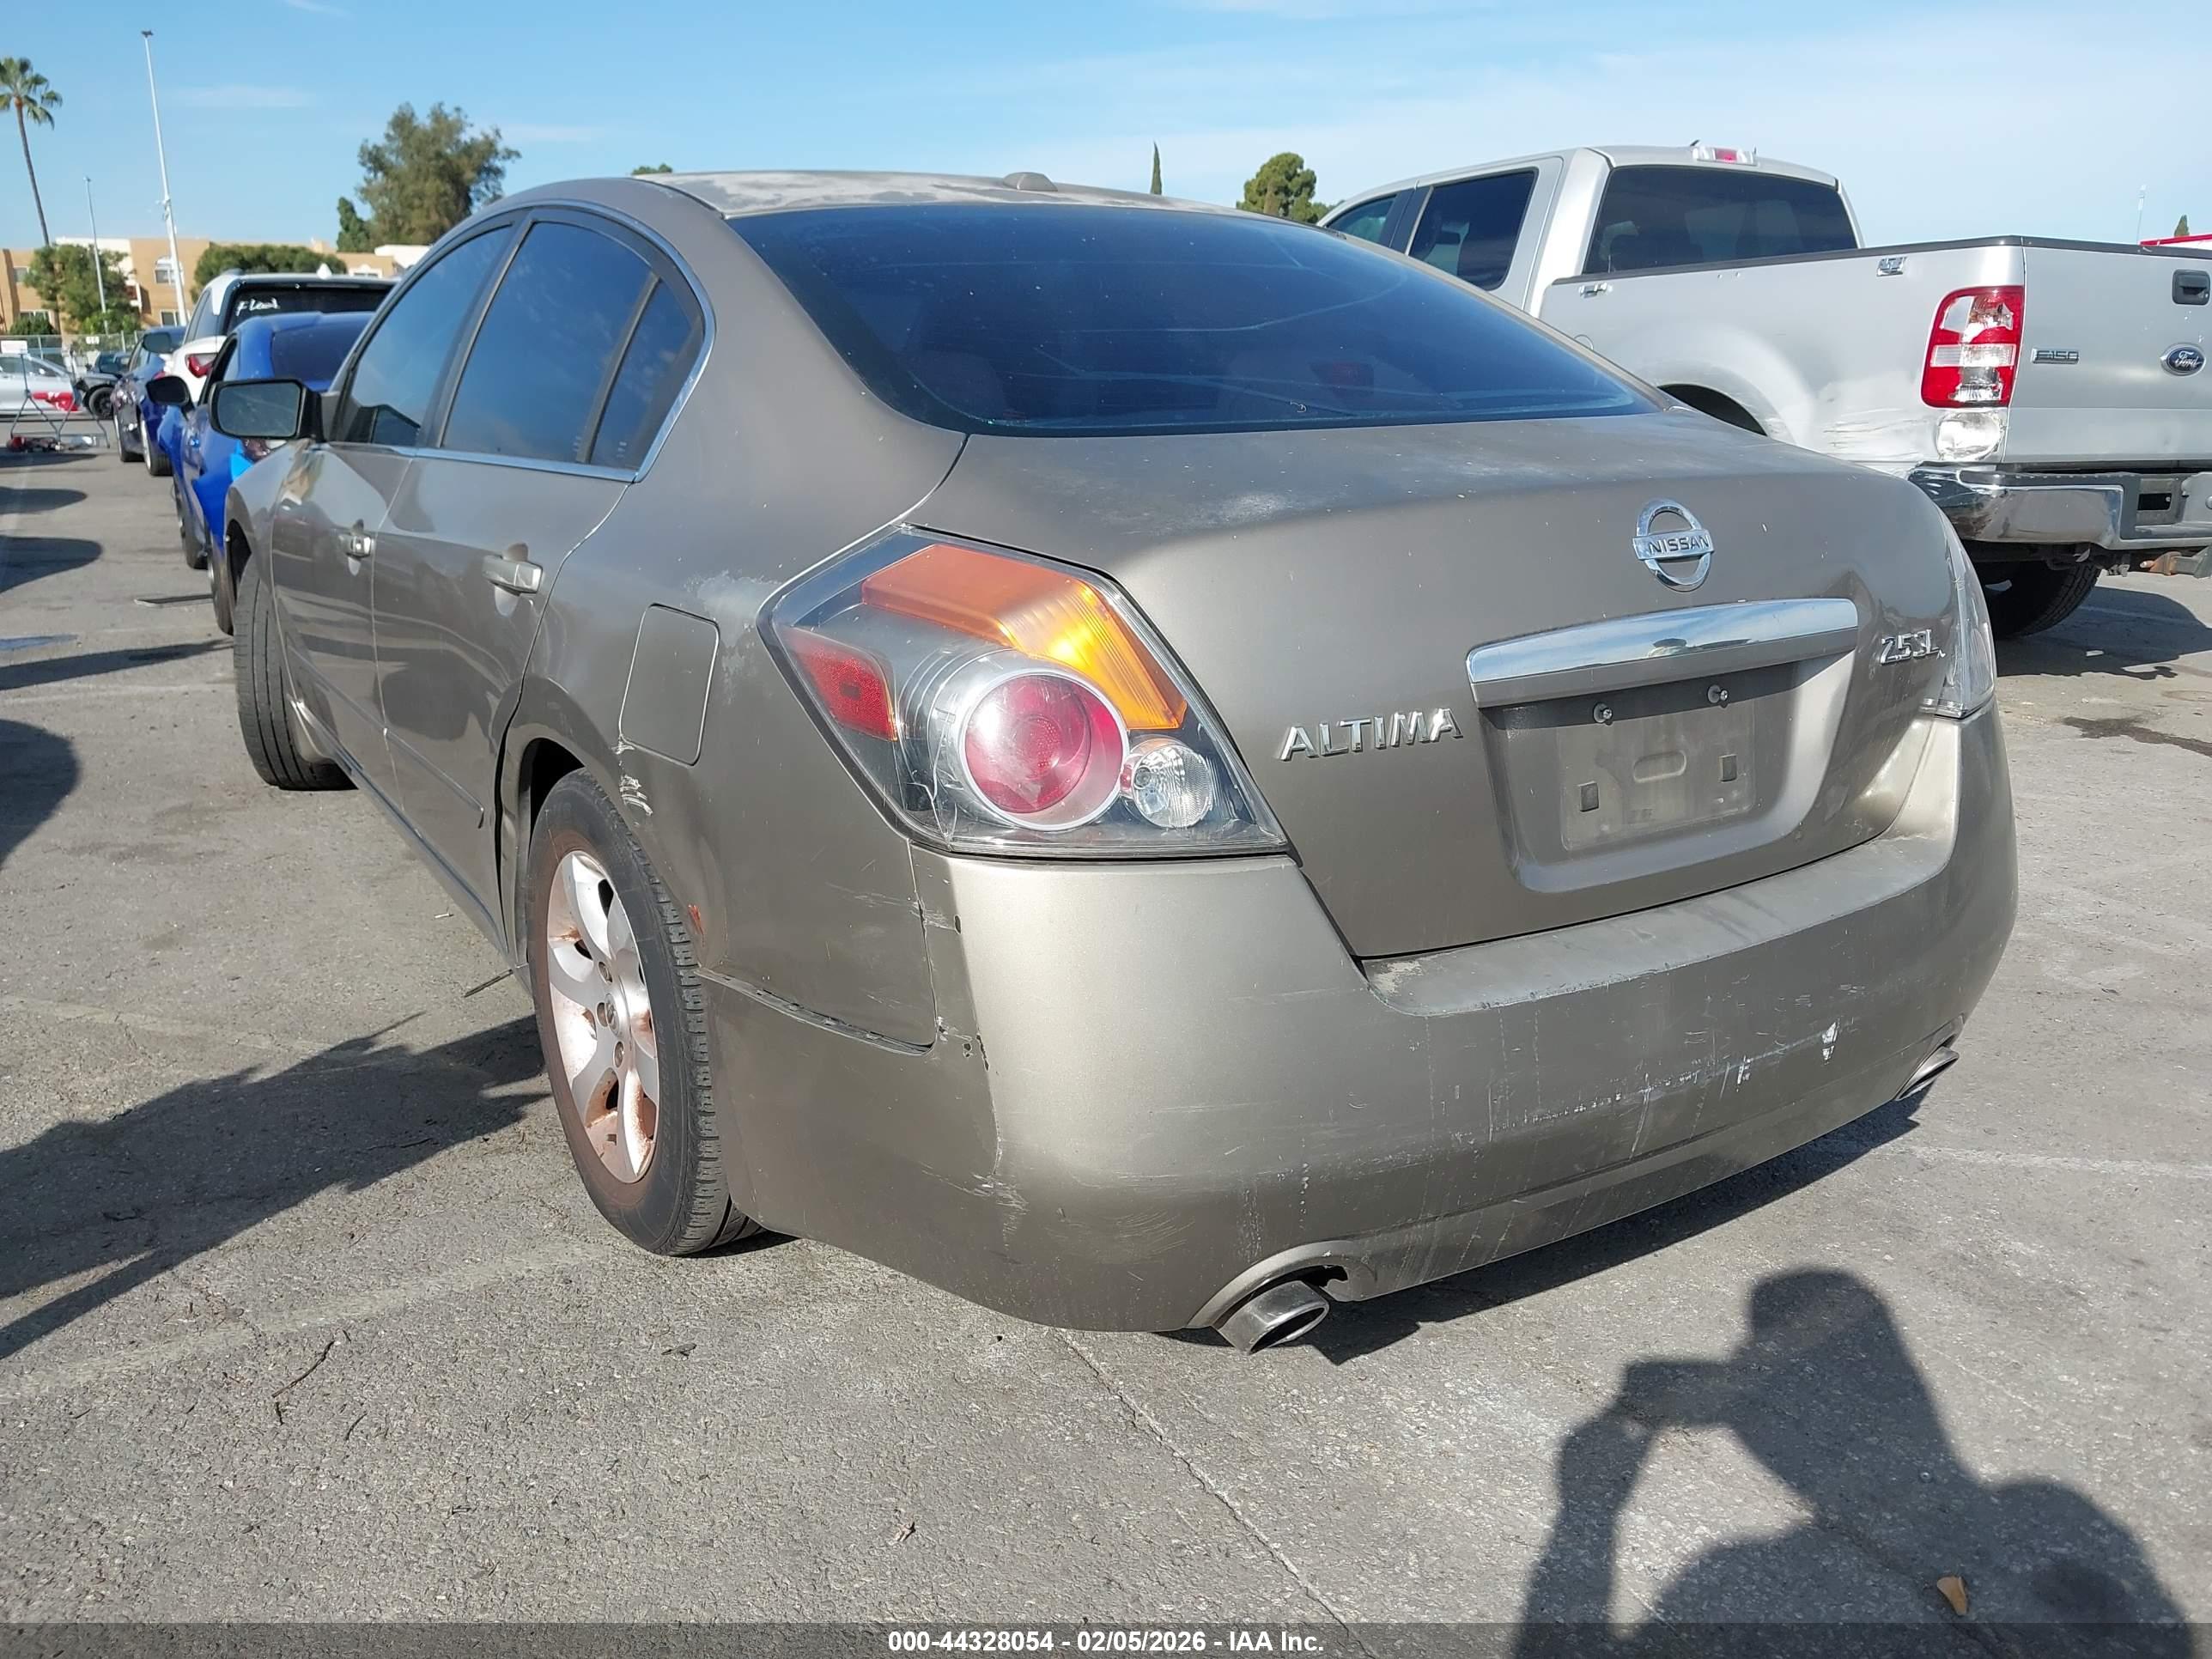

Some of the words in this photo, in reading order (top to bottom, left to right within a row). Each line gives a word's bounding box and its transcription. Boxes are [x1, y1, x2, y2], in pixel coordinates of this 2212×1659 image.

[2174, 350, 2203, 368] Ford
[1648, 534, 1711, 554] NISSAN
[1279, 707, 1463, 762] ALTIMA
